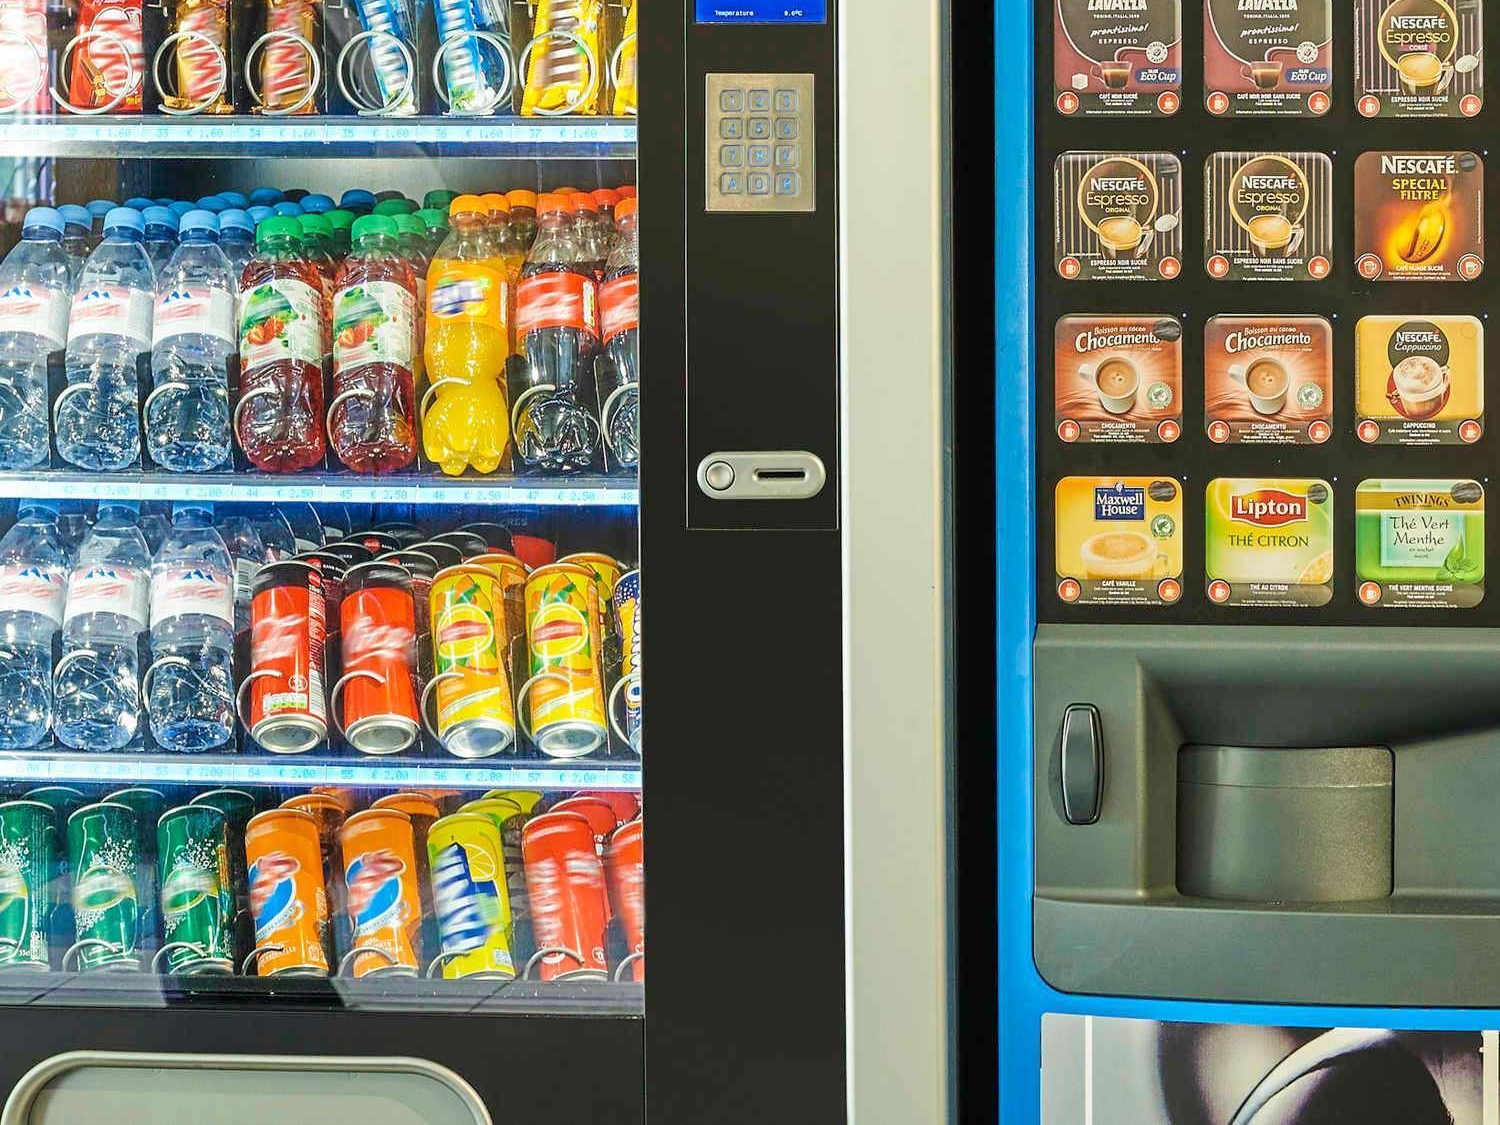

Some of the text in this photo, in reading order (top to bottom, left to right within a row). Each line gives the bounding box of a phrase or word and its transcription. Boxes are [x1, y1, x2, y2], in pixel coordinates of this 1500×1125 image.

[1386, 29, 1450, 47] Espresso
[1140, 71, 1157, 81] Eco
[1157, 71, 1177, 83] Cup
[1290, 71, 1327, 83] Eco Cup
[1392, 178, 1447, 190] SPECIAL
[1086, 191, 1149, 209] Espresso
[1237, 189, 1300, 207] Espresso
[1400, 190, 1440, 200] FILTRE
[1244, 327, 1268, 336] Boisson
[1225, 332, 1311, 354] Chocamento
[1394, 342, 1442, 353] Cappuccino
[433, 491, 445, 500] 46
[1096, 493, 1143, 505] Maxwell
[1393, 493, 1450, 508] TWININGS
[1102, 505, 1138, 517] House
[1237, 498, 1301, 519] Lipton
[1389, 516, 1451, 530] Thé Vert
[1228, 532, 1309, 547] THÉ CITRON
[1393, 531, 1445, 546] Menthe
[434, 771, 446, 781] 56
[528, 772, 540, 782] 57
